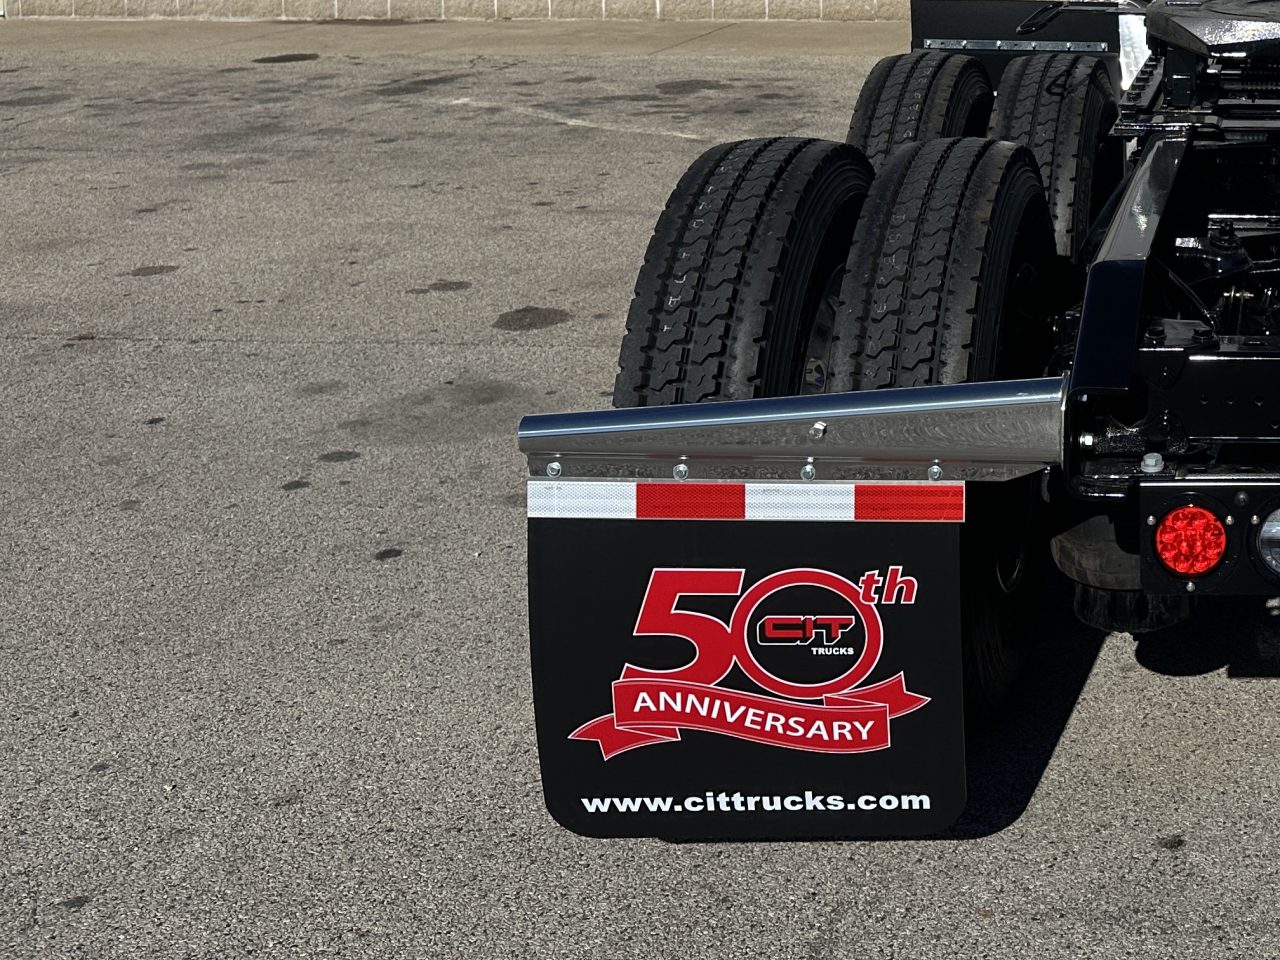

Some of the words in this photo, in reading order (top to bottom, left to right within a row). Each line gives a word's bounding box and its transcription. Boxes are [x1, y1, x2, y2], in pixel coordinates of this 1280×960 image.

[760, 615, 856, 642] CIT
[811, 646, 854, 656] TRUCKS
[633, 690, 875, 742] ANNIVERSARY
[581, 790, 932, 813] www.cittrucks.com
